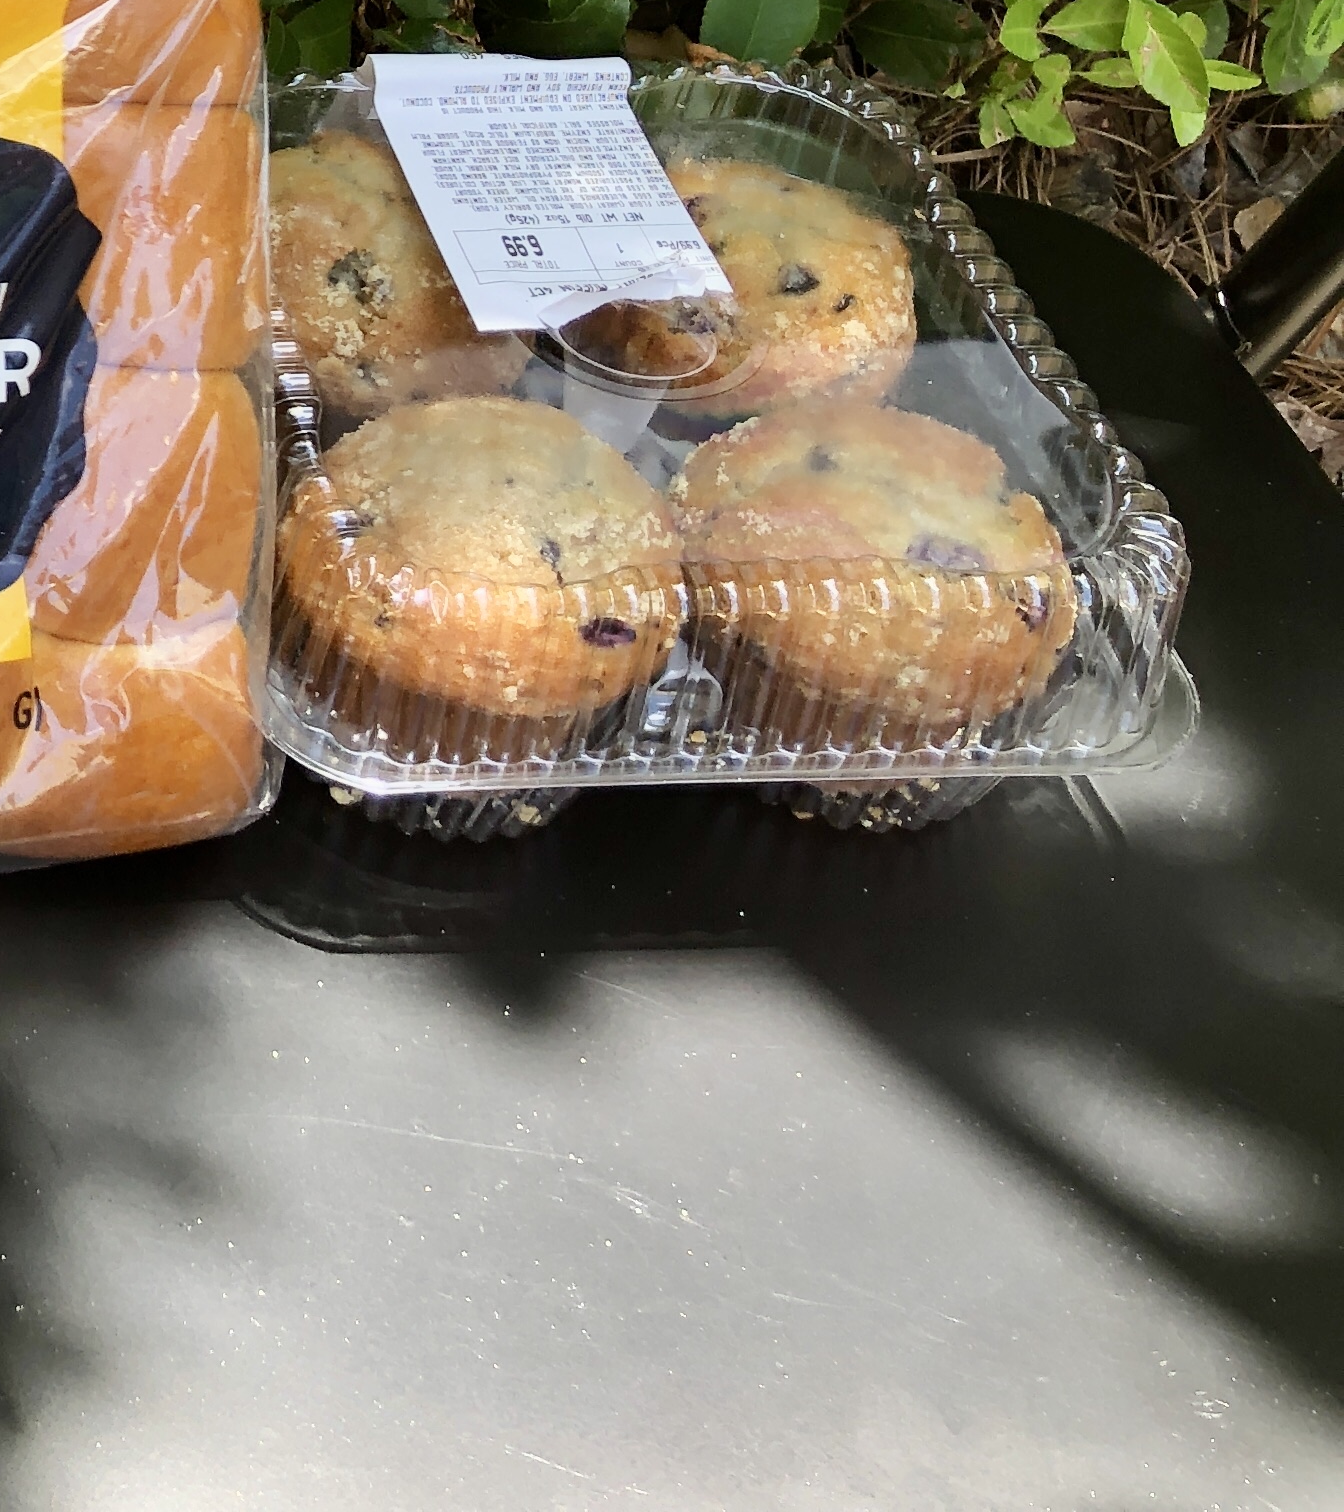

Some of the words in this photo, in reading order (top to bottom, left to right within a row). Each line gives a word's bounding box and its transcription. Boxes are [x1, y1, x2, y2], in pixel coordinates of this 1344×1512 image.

[623, 212, 644, 222] NET
[502, 235, 543, 257] 6.99
[616, 243, 624, 254] 1
[503, 261, 528, 269] PRICE
[532, 260, 560, 269] TOTAL
[528, 287, 552, 297] 4CT
[12, 687, 43, 731] G)
